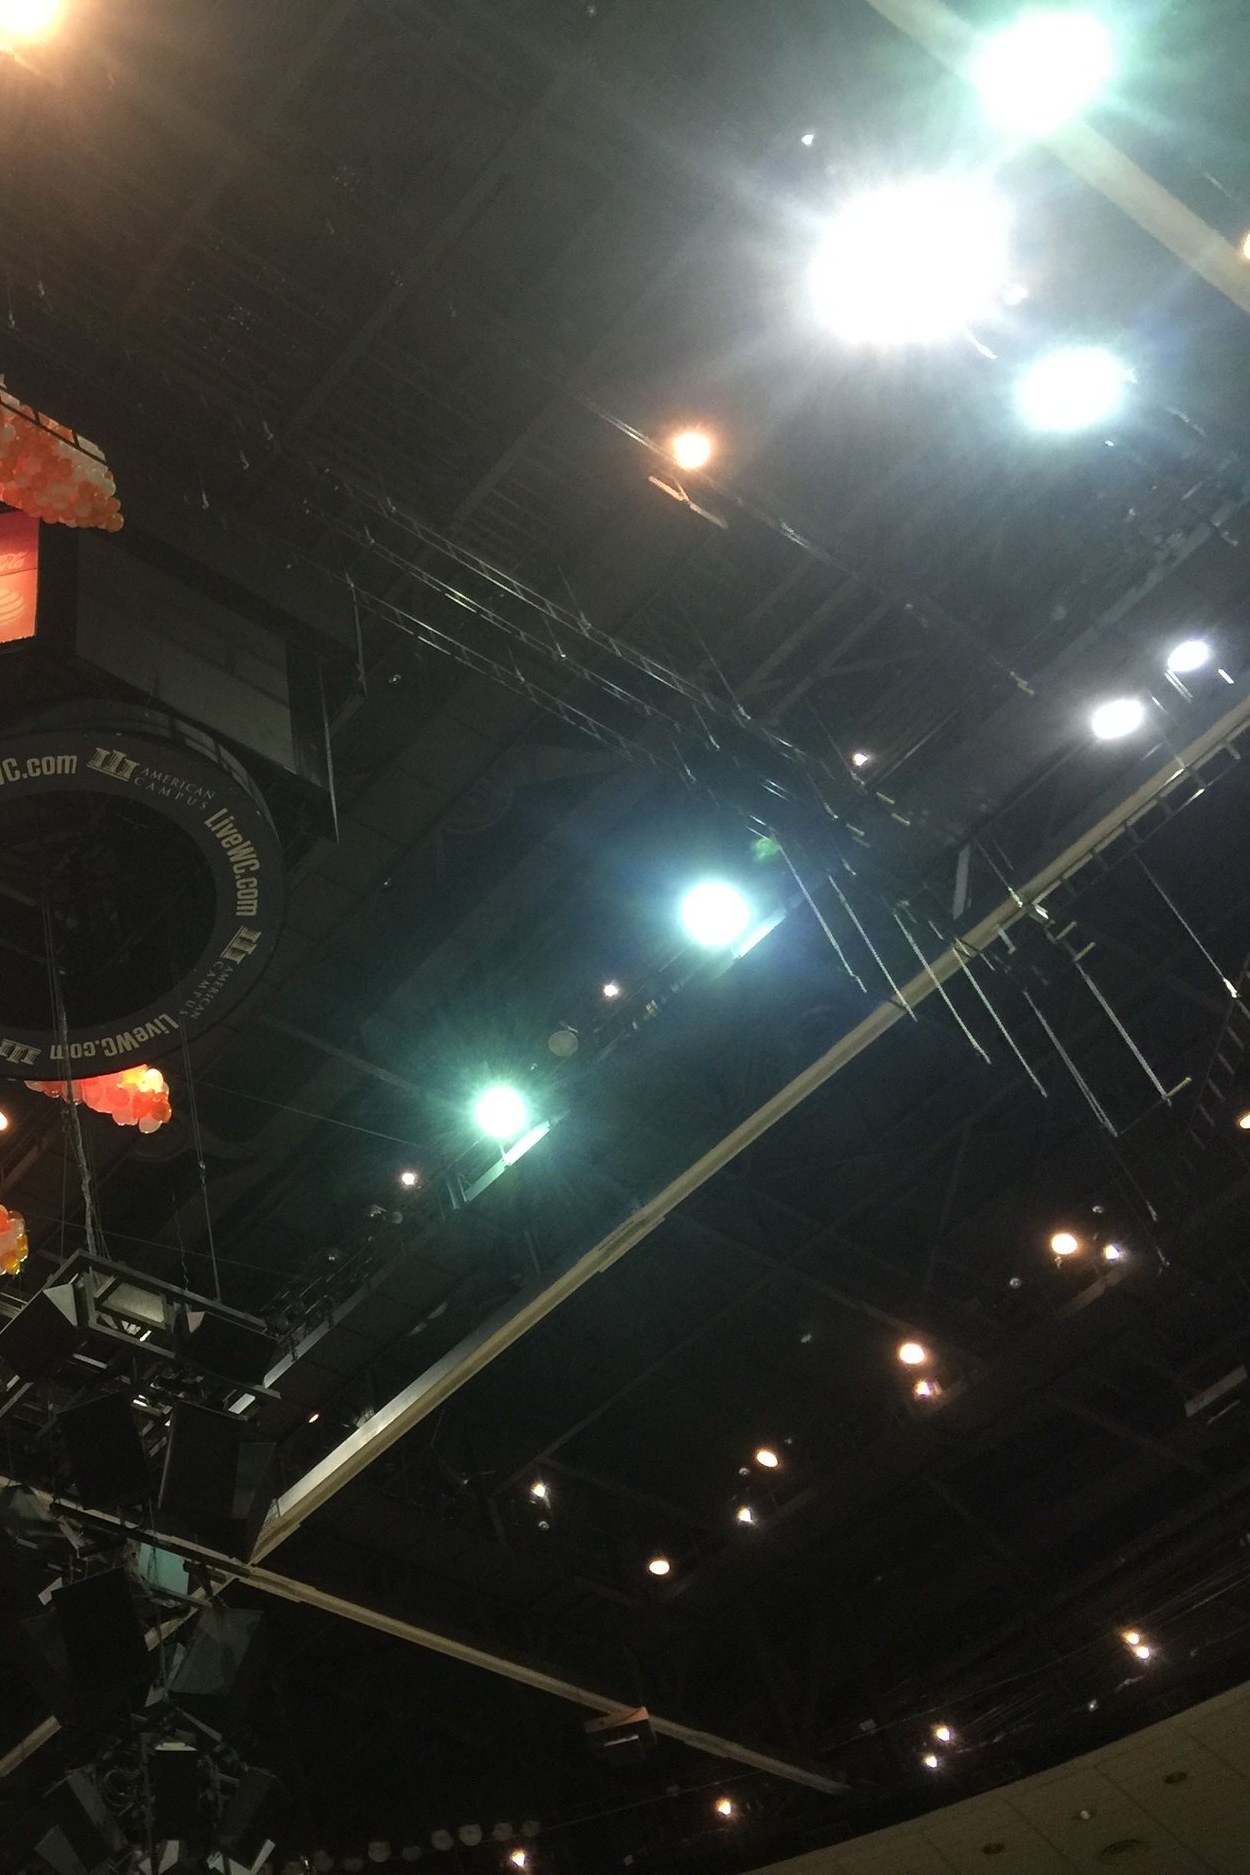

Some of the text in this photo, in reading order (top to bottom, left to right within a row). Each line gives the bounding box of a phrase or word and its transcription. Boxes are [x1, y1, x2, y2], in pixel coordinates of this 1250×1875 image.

[134, 776, 208, 810] CAMPUS
[141, 768, 216, 800] AMERICAN
[204, 808, 260, 916] LiveWC.com
[190, 964, 234, 1019] AMERICAN
[50, 1013, 180, 1060] LiveWC.com
